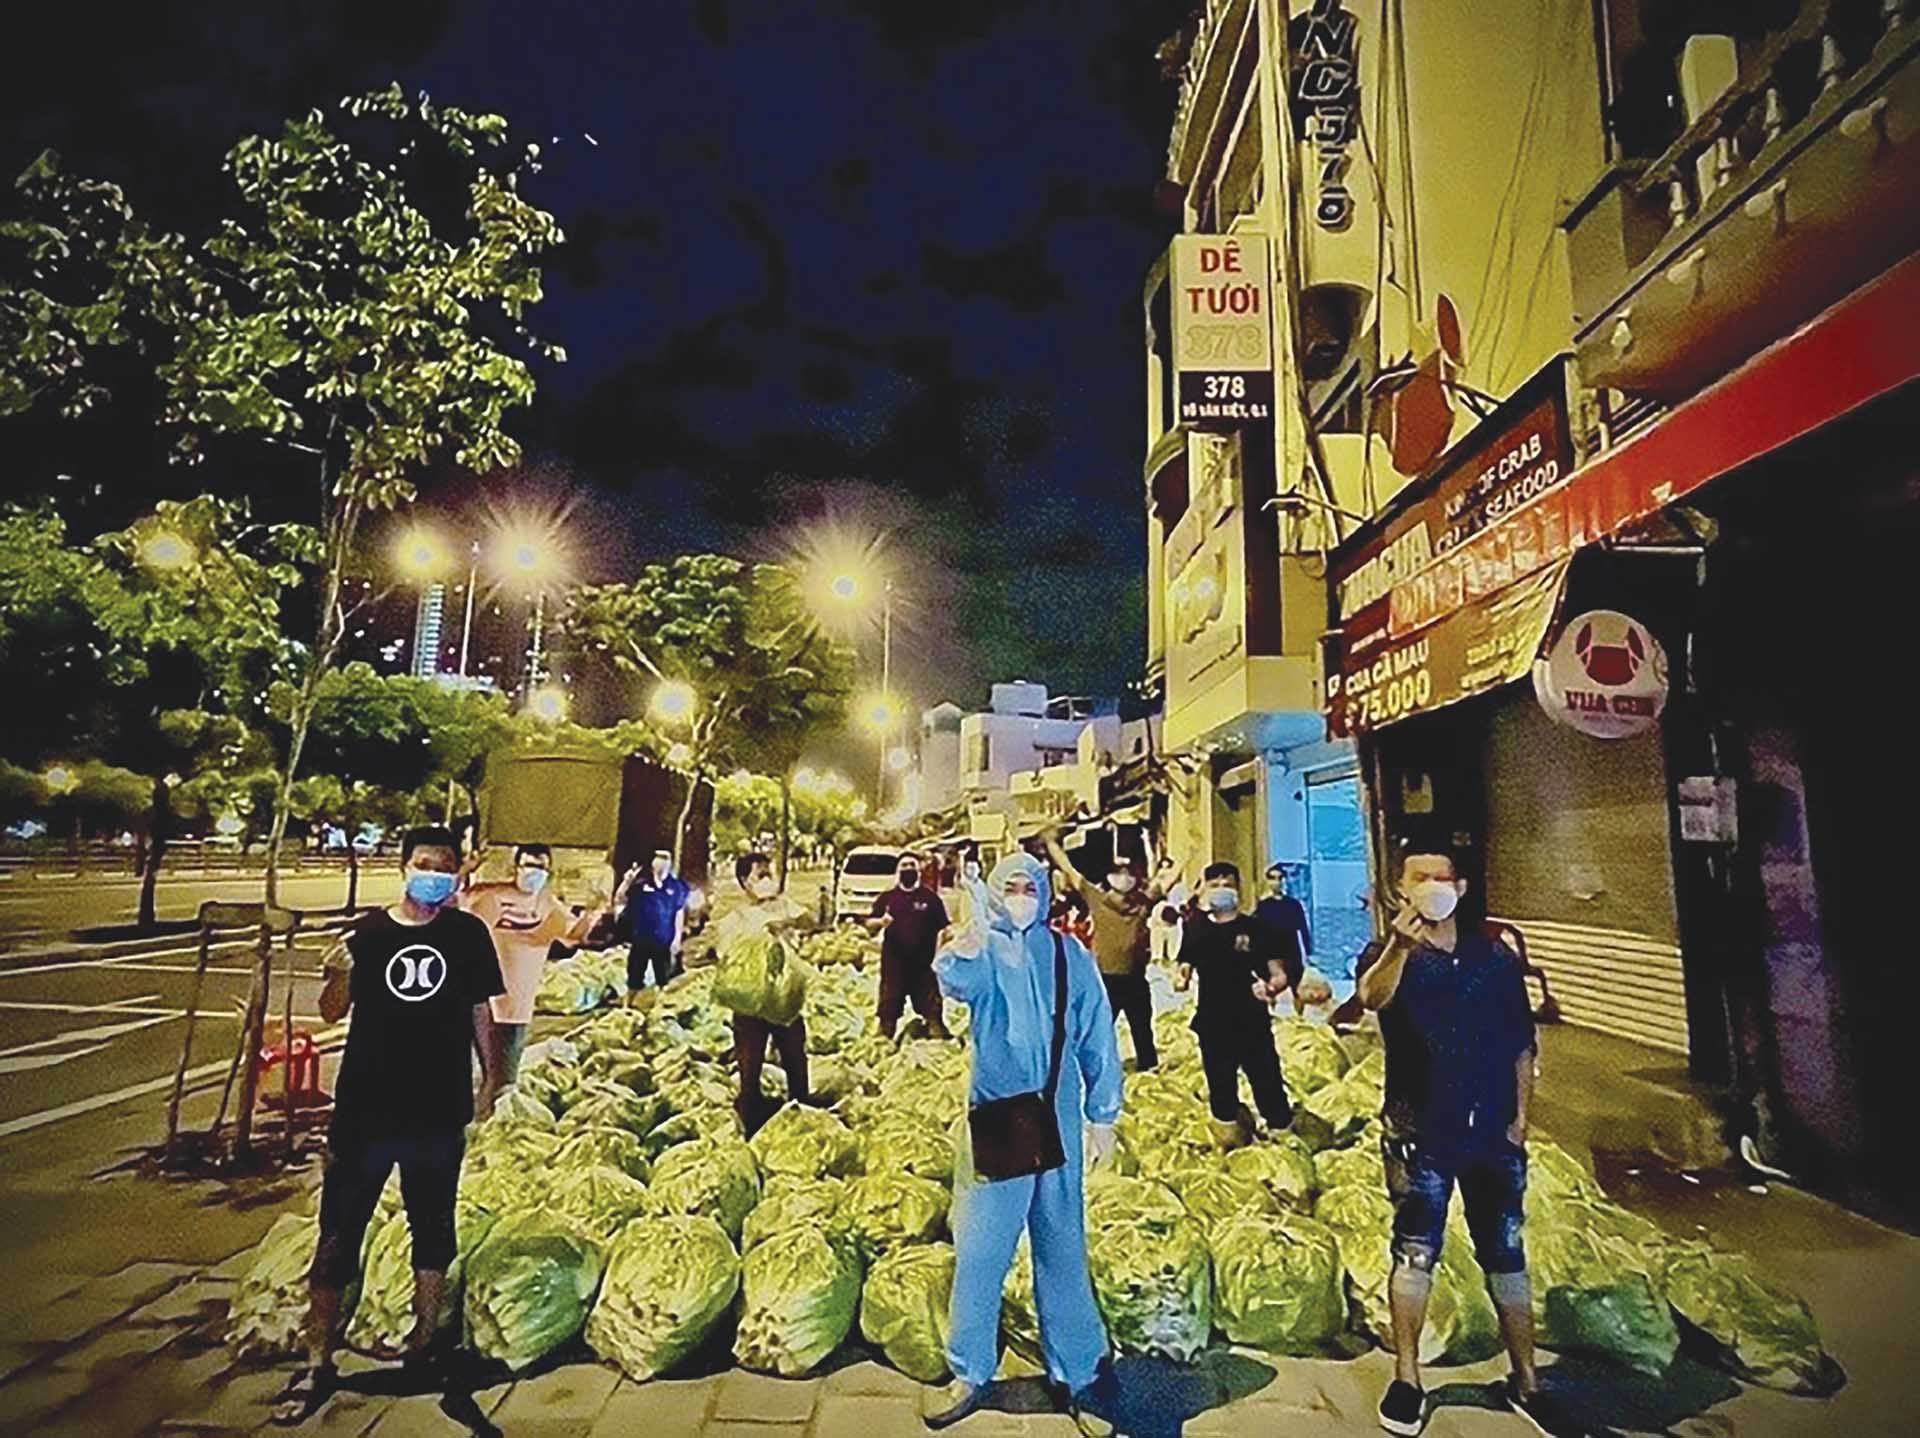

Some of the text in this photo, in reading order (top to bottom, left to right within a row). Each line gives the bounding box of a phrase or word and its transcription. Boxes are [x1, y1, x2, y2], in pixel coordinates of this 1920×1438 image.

[1201, 240, 1242, 272] DÊ
[1186, 283, 1260, 314] TƯƠI
[1204, 376, 1245, 398] 378
[1499, 433, 1542, 480] CRAB
[1485, 460, 1559, 519] SEAFOOD
